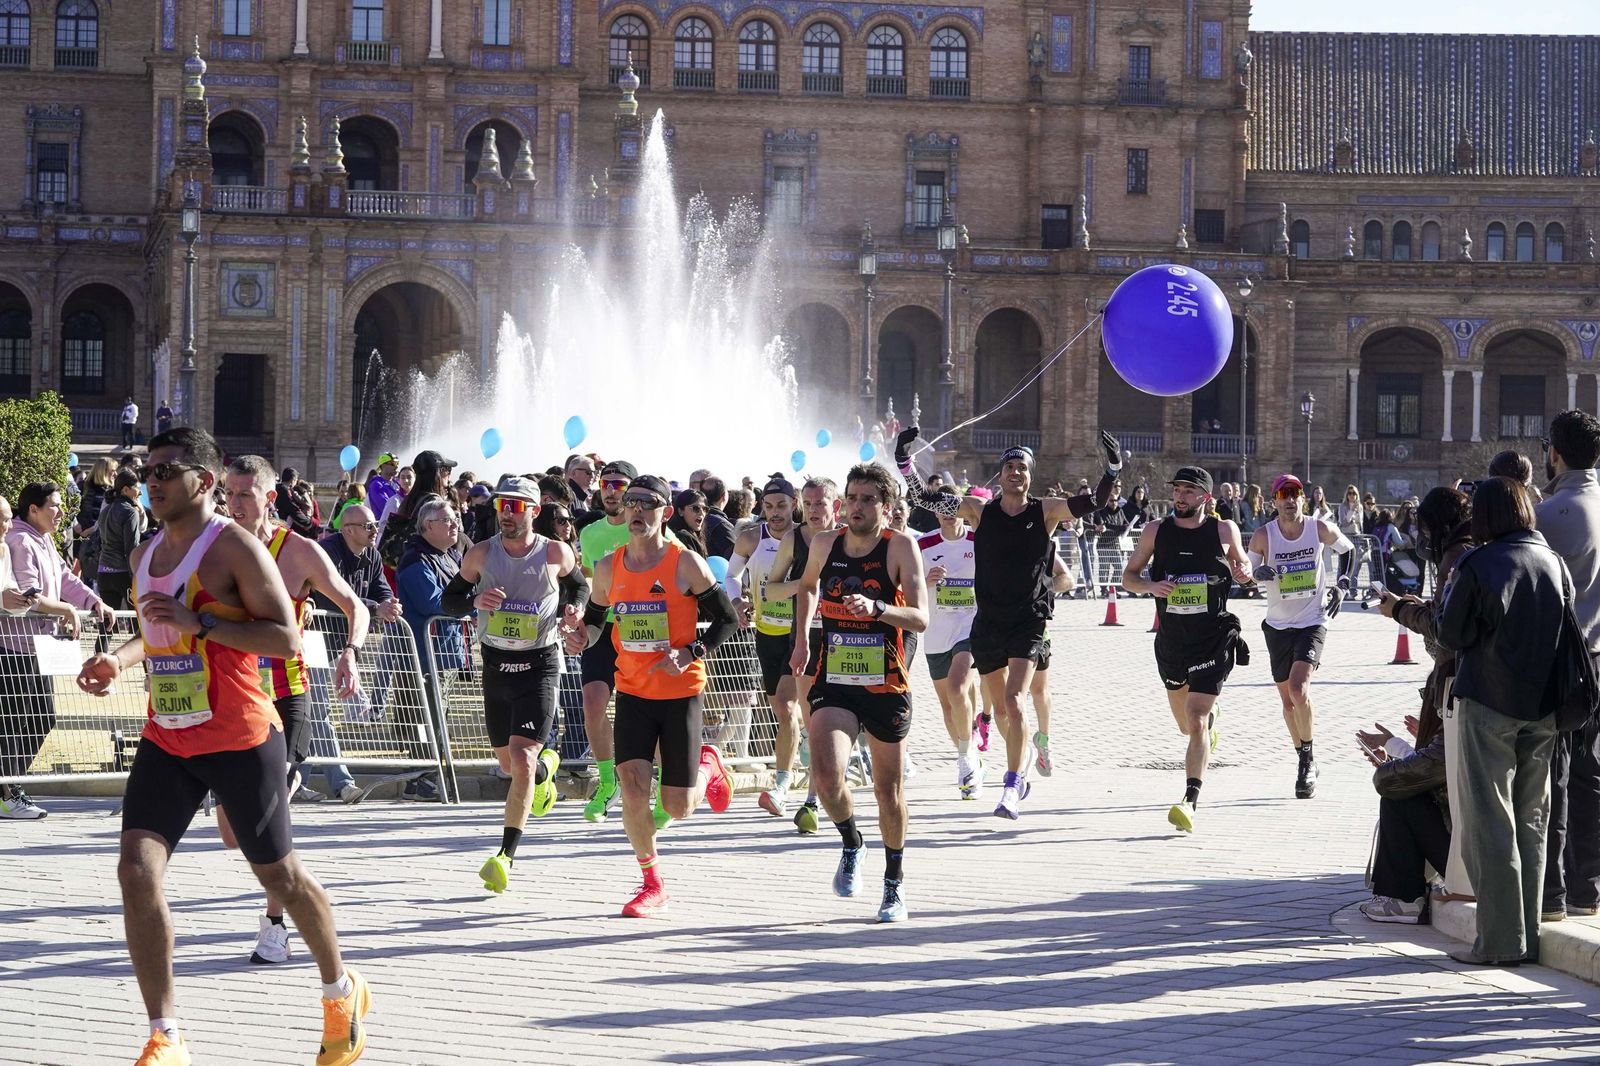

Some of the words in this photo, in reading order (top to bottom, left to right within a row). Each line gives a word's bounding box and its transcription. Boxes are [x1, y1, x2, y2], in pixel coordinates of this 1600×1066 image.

[1167, 281, 1198, 317] 2:45
[504, 602, 535, 612] ZURICH
[630, 604, 660, 612] ZURICH
[505, 617, 520, 625] 1547
[838, 621, 870, 630] REKALDE
[502, 626, 521, 638] CEA
[629, 629, 655, 640] JOAN
[845, 636, 877, 644] ZURICH
[846, 652, 863, 660] 2113
[155, 659, 193, 671] ZURICH
[841, 662, 869, 673] FRUN
[156, 696, 193, 712] ARJUN
